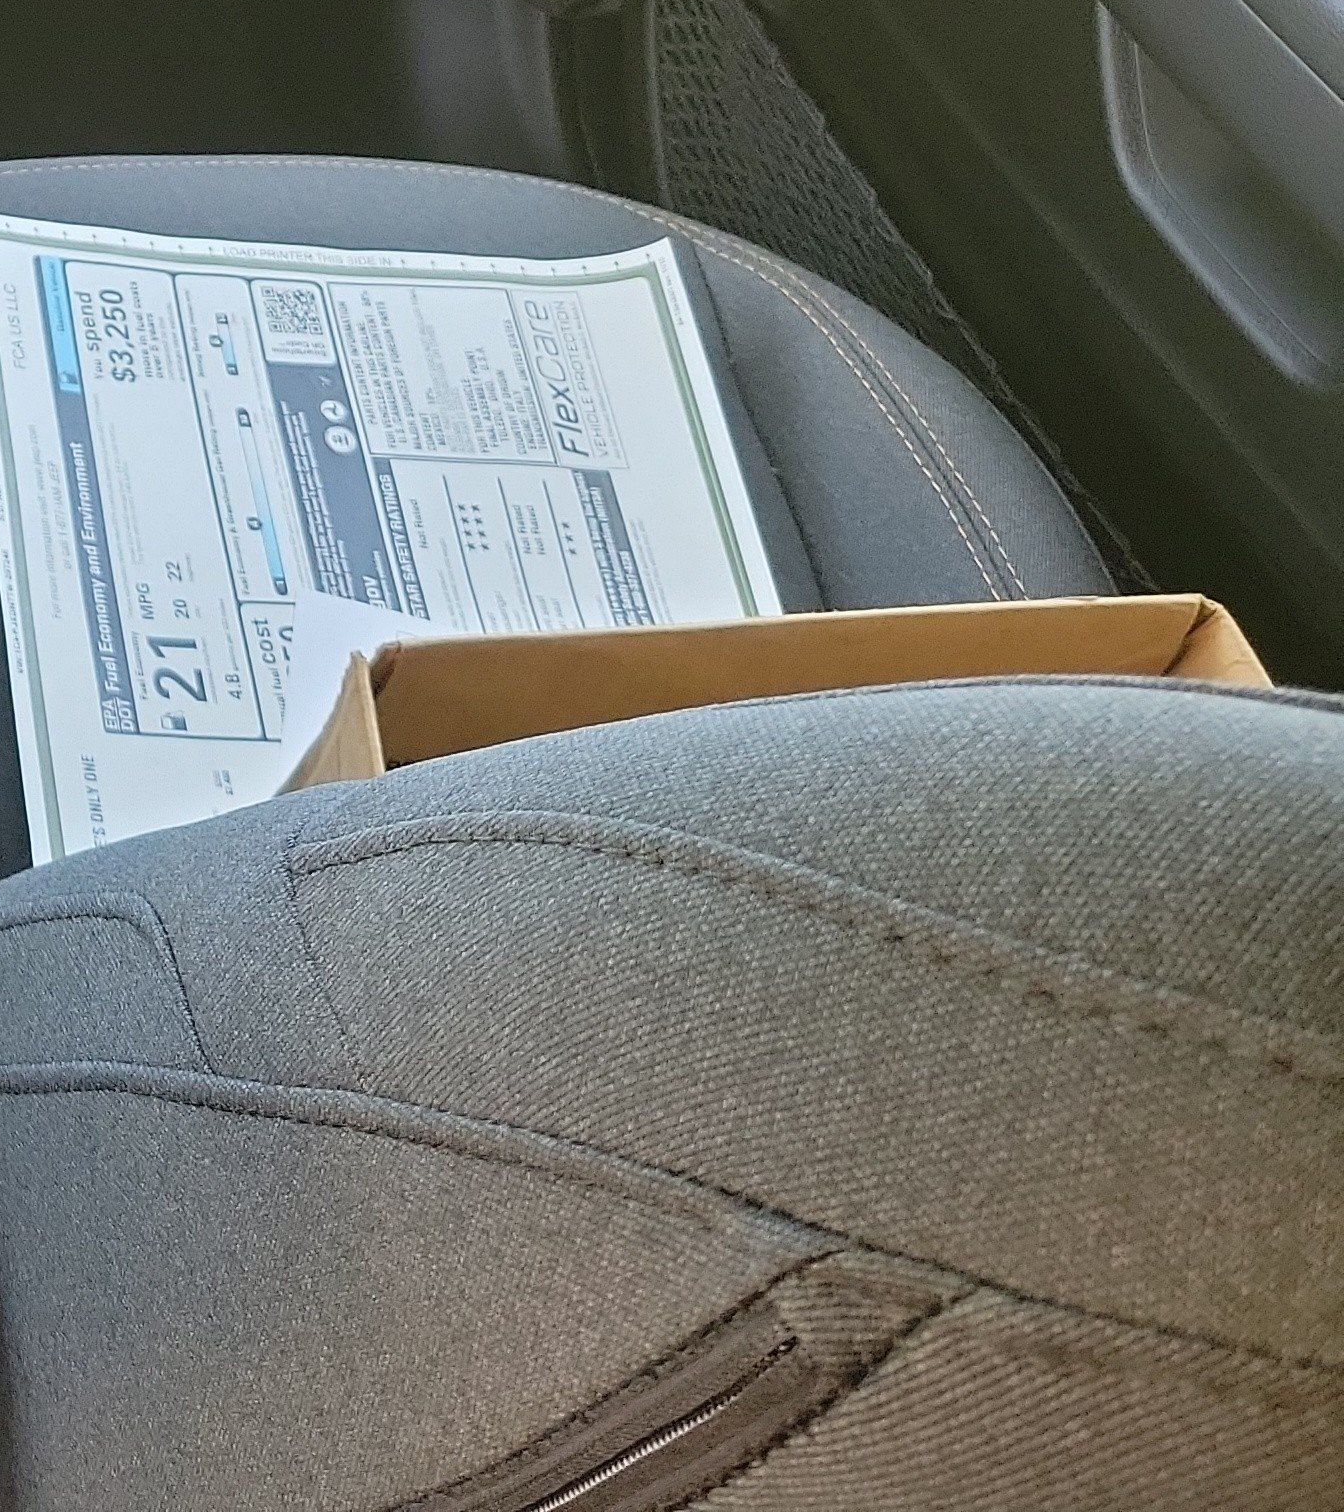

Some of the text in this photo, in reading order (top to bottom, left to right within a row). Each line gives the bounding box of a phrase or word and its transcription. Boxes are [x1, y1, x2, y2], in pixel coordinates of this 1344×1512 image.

[223, 246, 256, 256] LOAD
[259, 249, 311, 260] PRINTER
[316, 254, 344, 264] THIS
[380, 257, 392, 267] IN
[3, 282, 27, 370] FCA US LLC
[74, 290, 105, 380] You spend
[99, 288, 137, 384] $3,250
[145, 312, 159, 343] years
[366, 313, 390, 379] PARTS CONTENT
[553, 300, 590, 392] PROTECTION
[339, 301, 377, 426] PARTS CONTENT INFORMATION
[524, 300, 590, 457] FlexCare
[580, 397, 609, 459] VEHICLE
[379, 473, 404, 530] RATINGS
[410, 498, 428, 549] Not Rated
[512, 504, 532, 555] Not Rated
[526, 504, 547, 556] Not Rated
[69, 442, 120, 693] Fuel Economy and Environment
[165, 560, 183, 583] 22
[390, 531, 414, 583] SAFETY
[136, 582, 155, 621] MPG
[172, 598, 191, 619] 20
[405, 583, 429, 620] STAR
[254, 618, 276, 665] cost
[145, 634, 208, 703] 21
[102, 699, 117, 730] EPA
[117, 698, 133, 733] DOT
[81, 754, 103, 823] ONLY ONE
